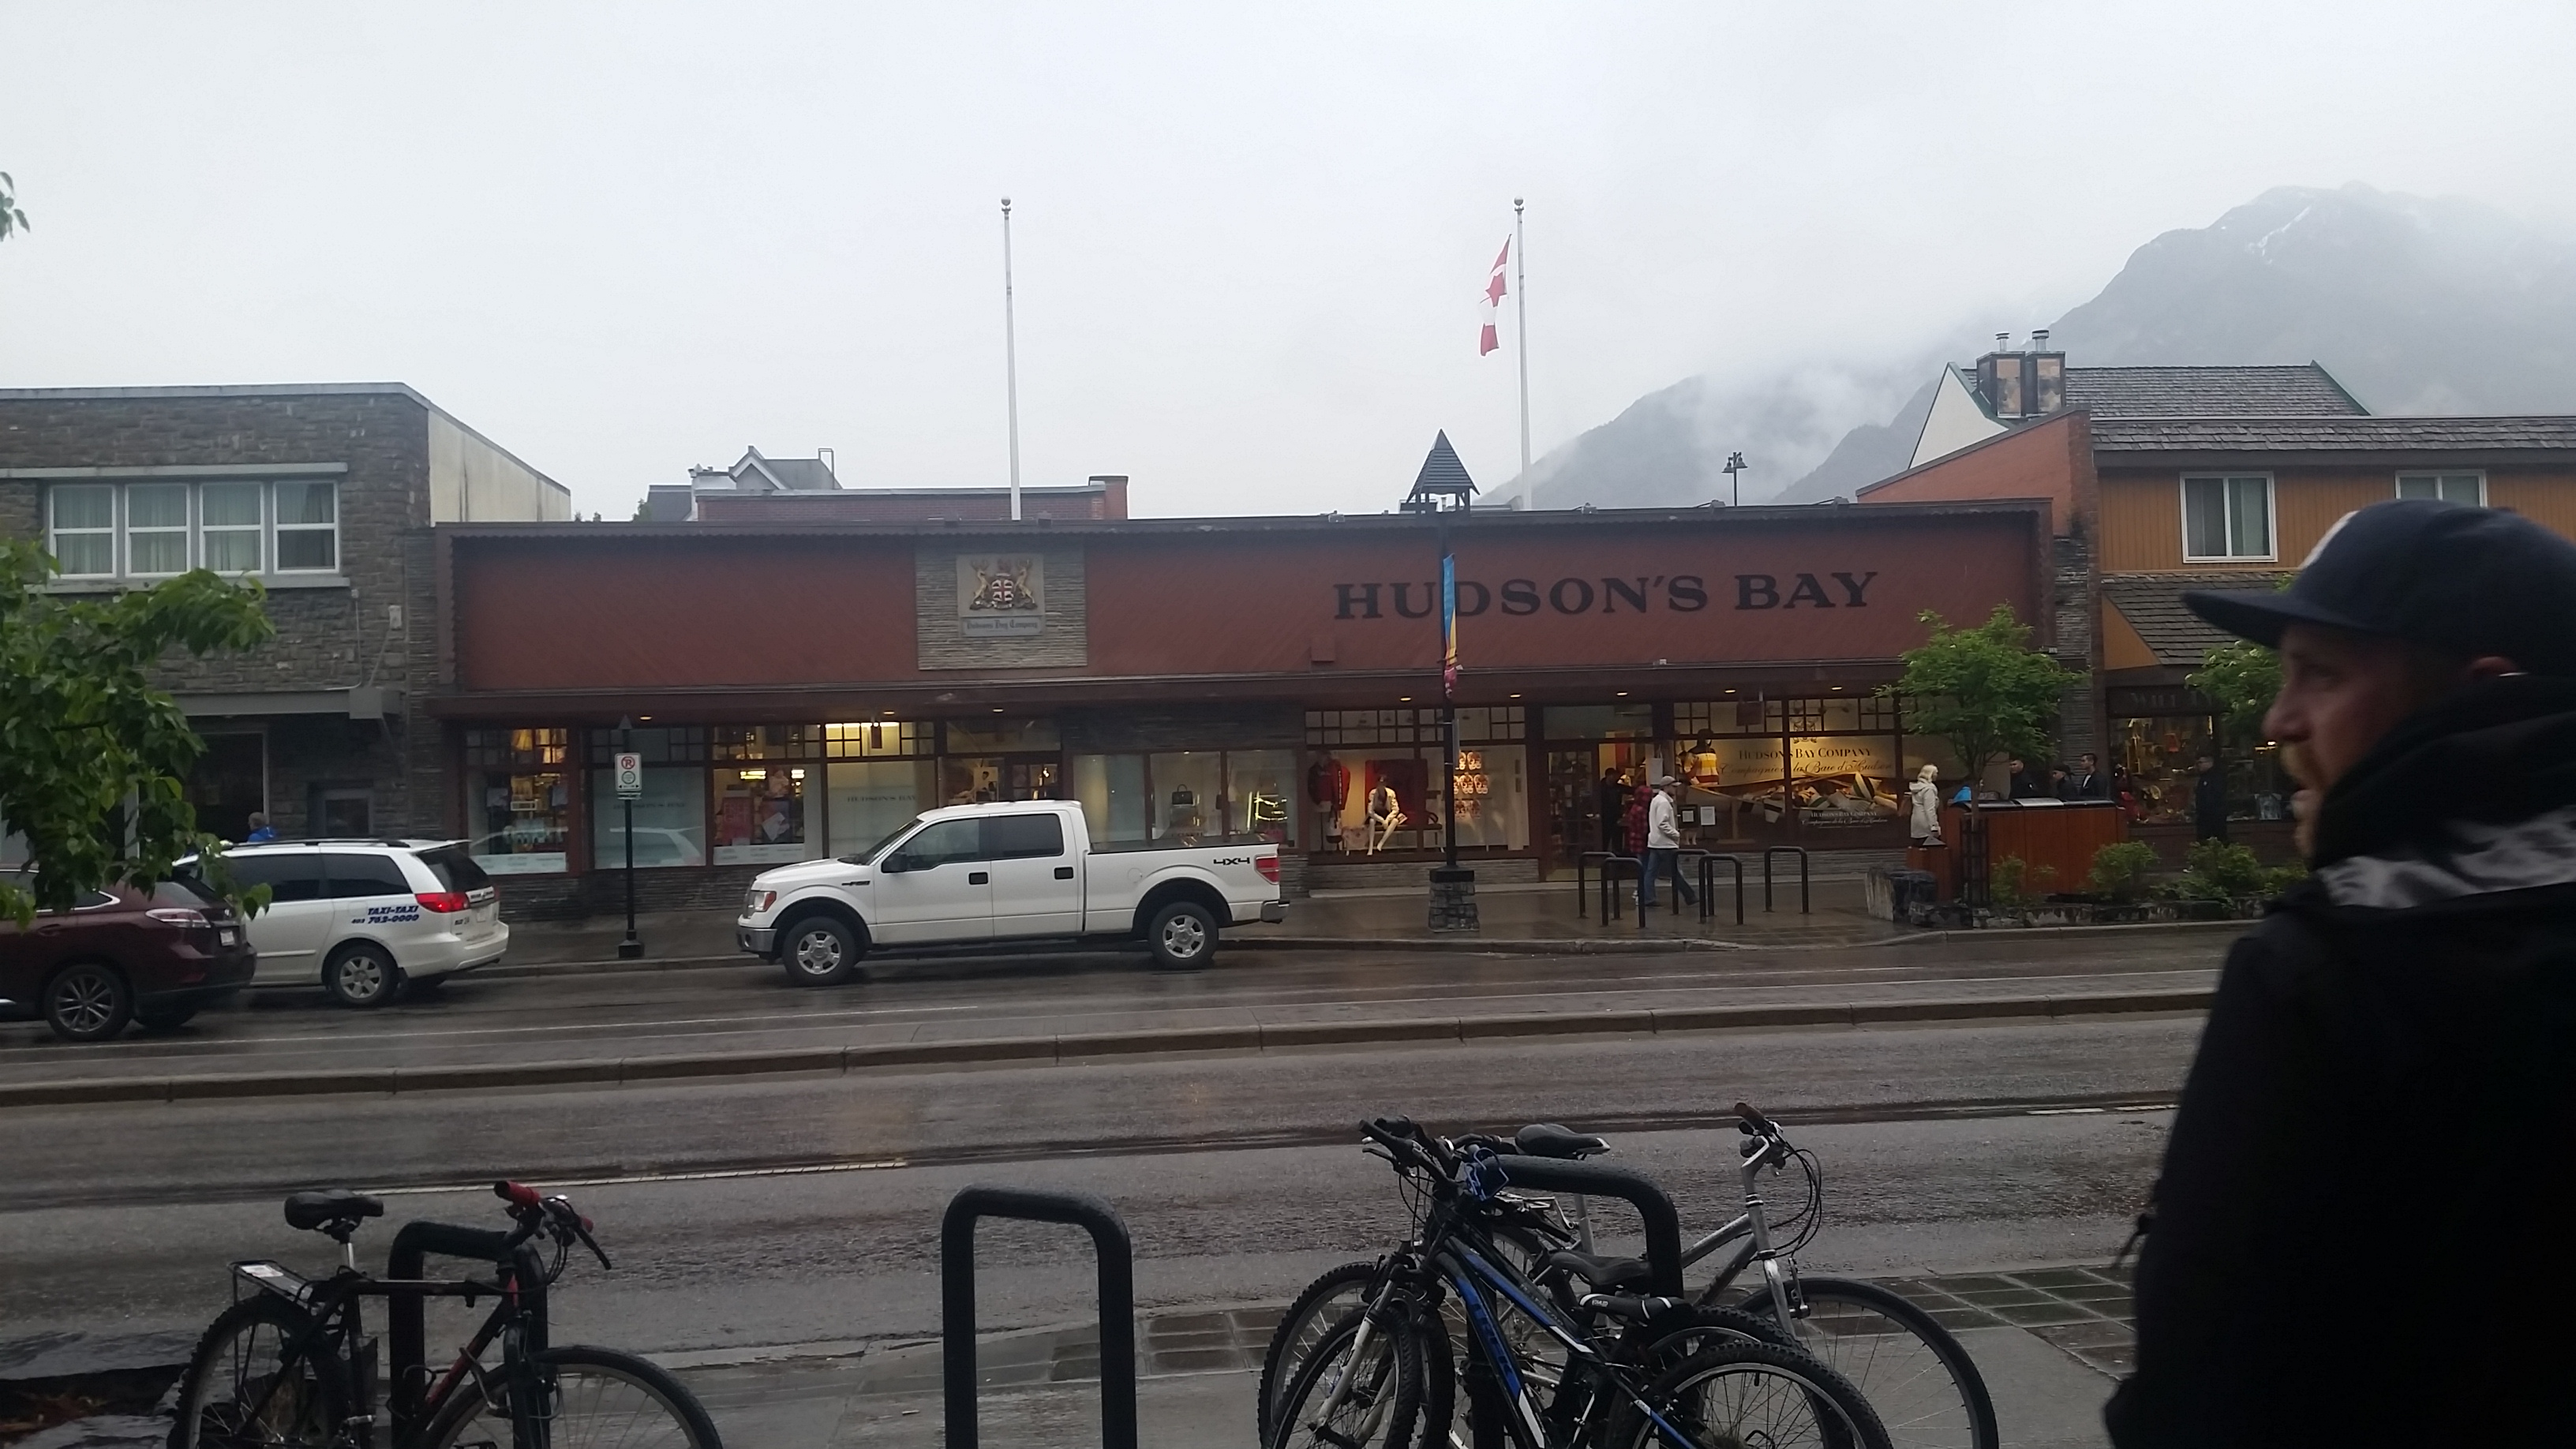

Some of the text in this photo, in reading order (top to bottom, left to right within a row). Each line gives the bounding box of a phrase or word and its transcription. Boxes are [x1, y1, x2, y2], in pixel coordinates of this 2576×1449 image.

[1333, 571, 1878, 620] HUDSON'S BAY
[1739, 747, 1870, 760] HUDSONS BAY COMPANY
[368, 905, 419, 915] TAXI-TAXI
